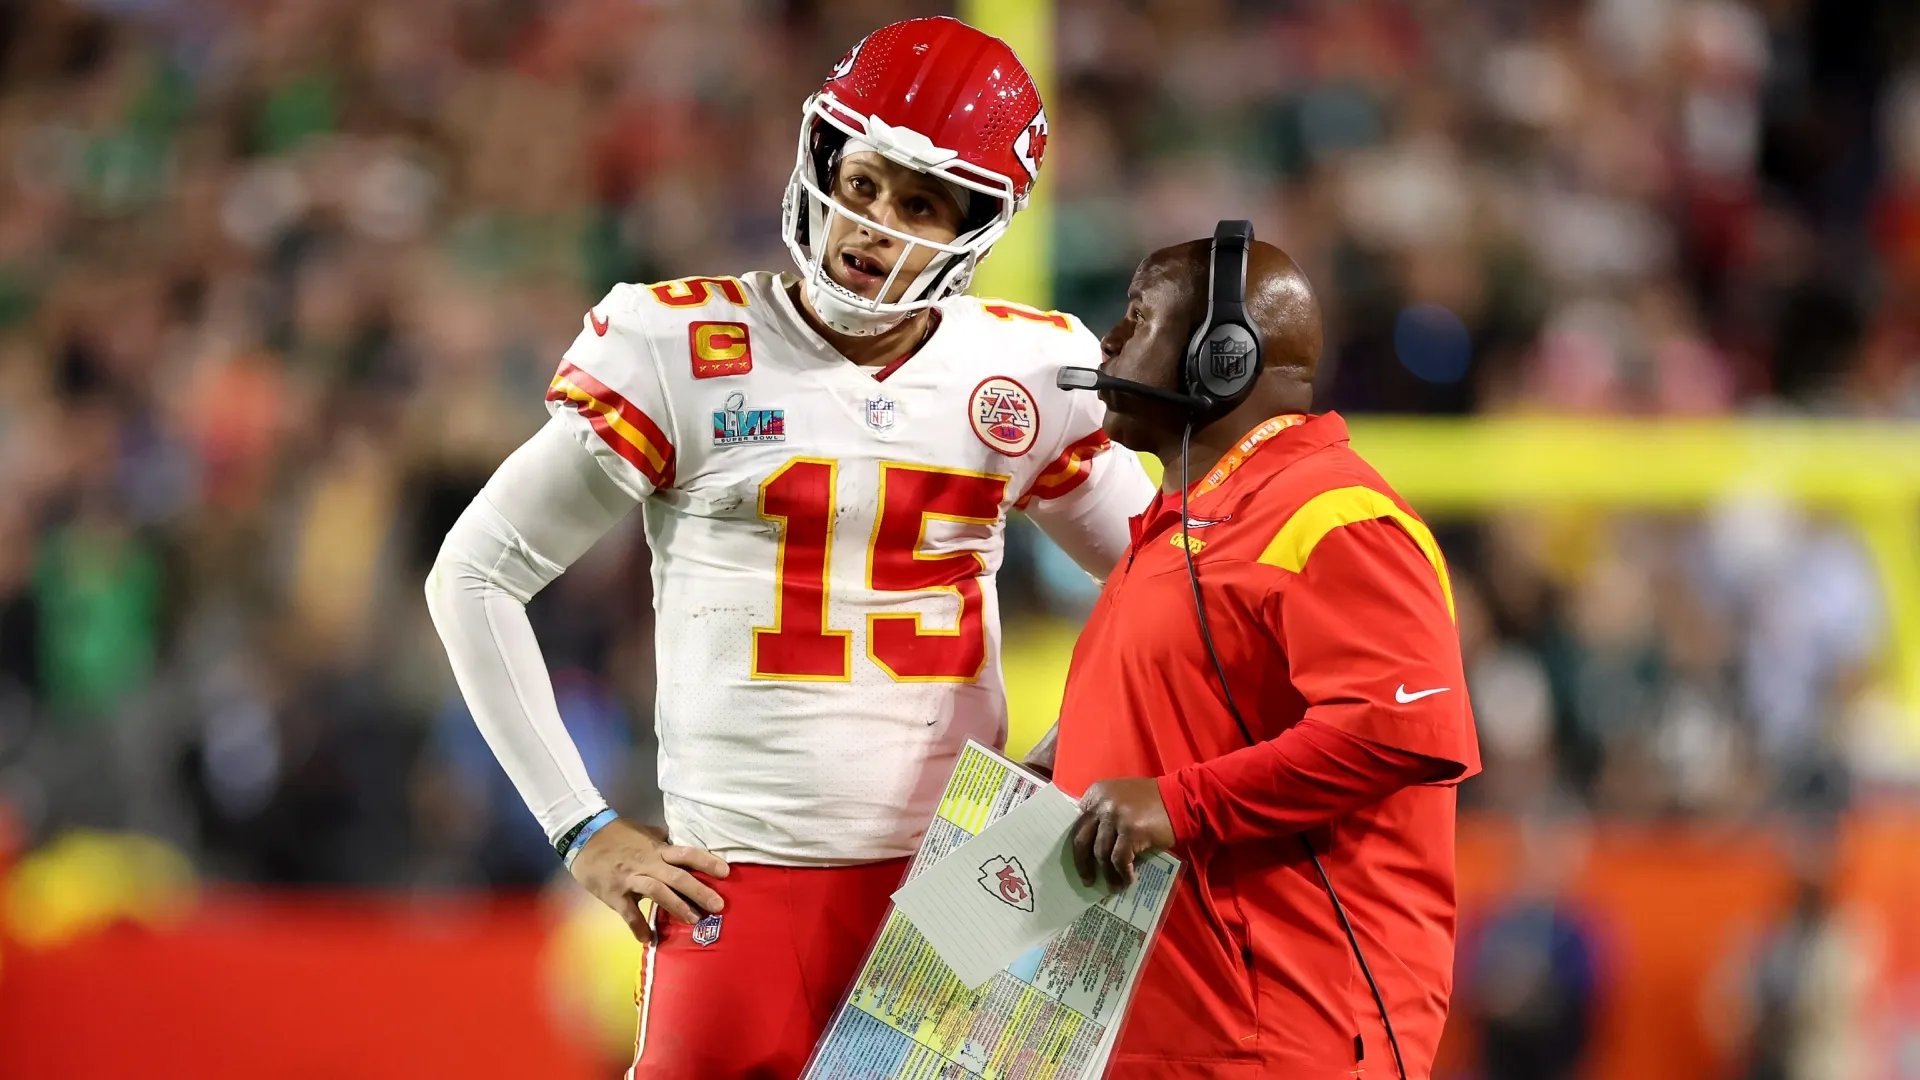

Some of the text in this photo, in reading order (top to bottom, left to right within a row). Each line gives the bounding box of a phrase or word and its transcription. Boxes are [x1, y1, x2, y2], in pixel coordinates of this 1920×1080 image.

[695, 324, 747, 361] C
[1212, 355, 1245, 375] NFL
[713, 409, 784, 439] LVII
[872, 410, 892, 425] NFL
[981, 387, 1030, 427] A
[751, 456, 1012, 684] 15
[996, 865, 1027, 902] KC
